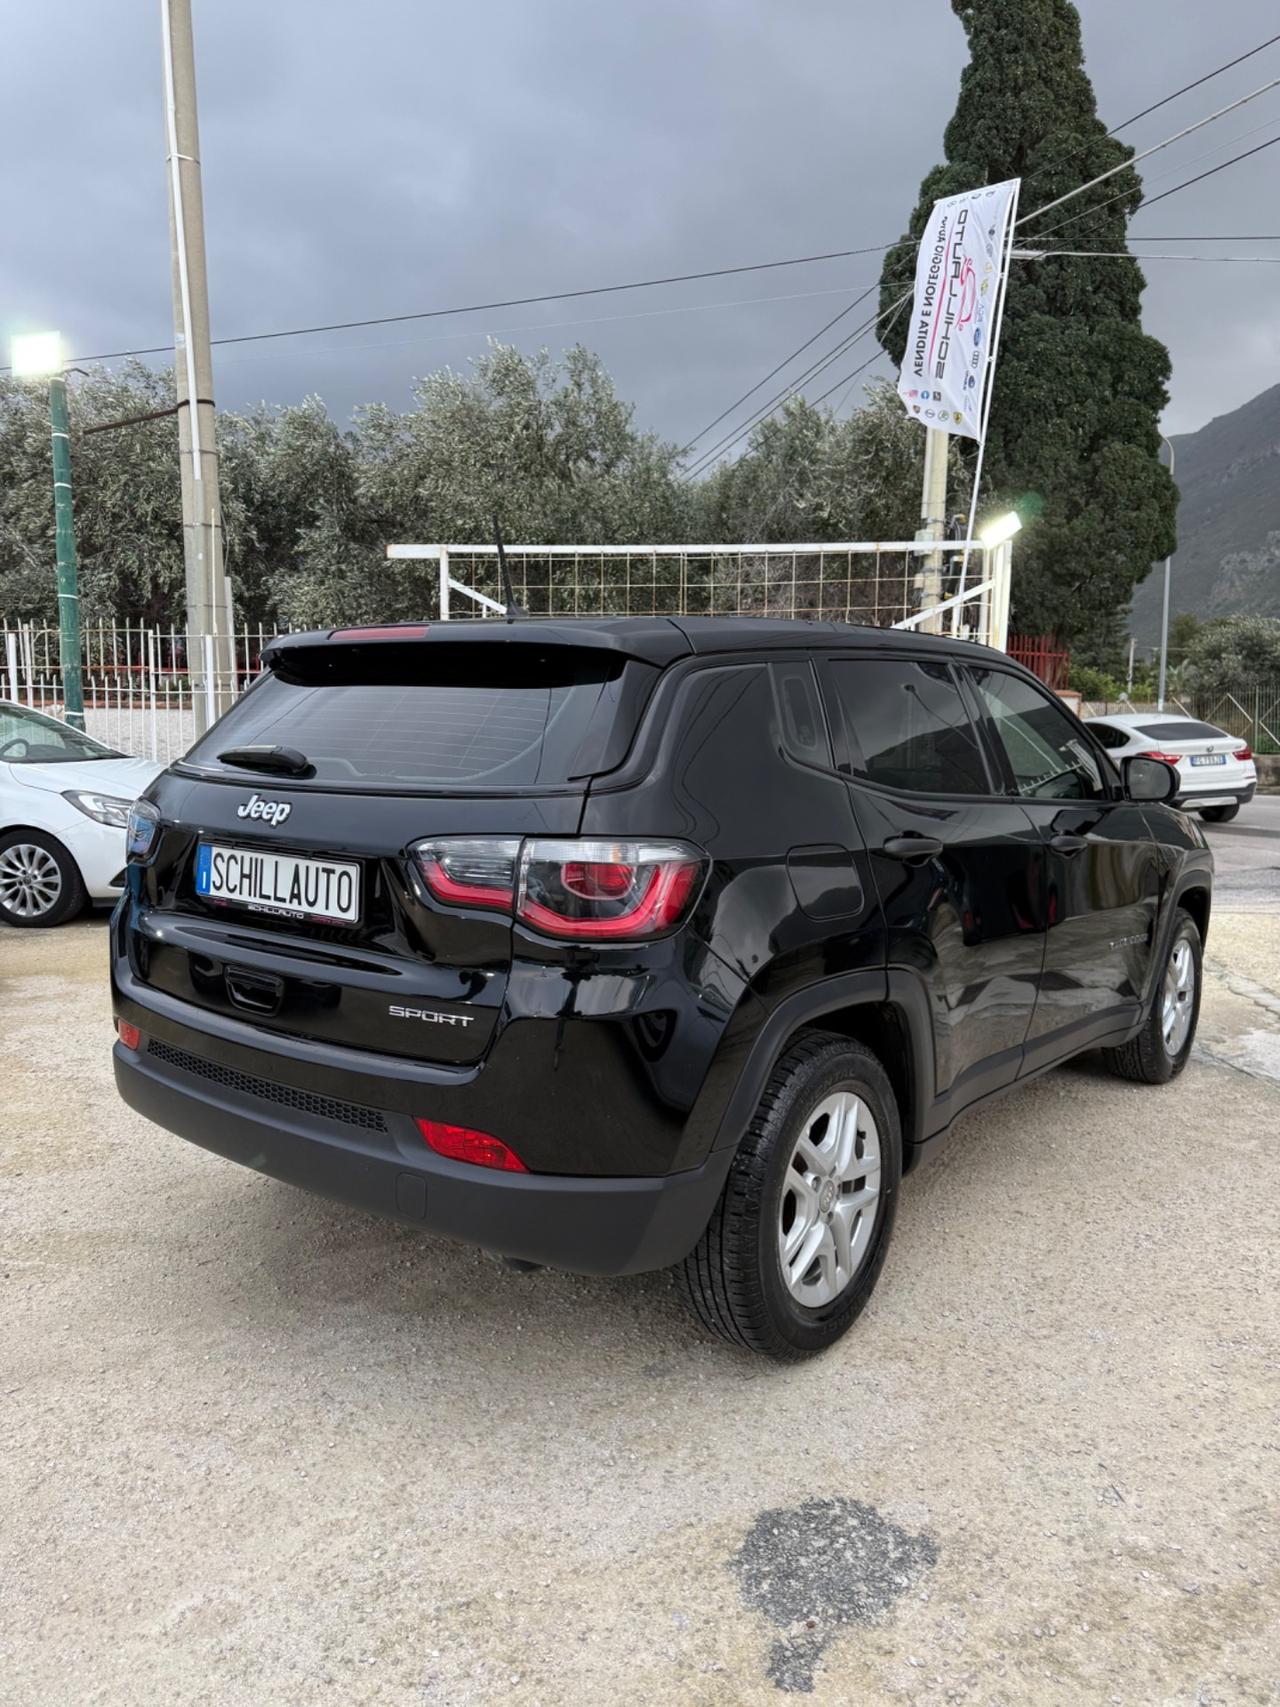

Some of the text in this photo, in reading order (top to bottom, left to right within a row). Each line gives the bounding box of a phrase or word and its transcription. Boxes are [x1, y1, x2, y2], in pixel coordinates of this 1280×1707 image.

[237, 794, 291, 826] Jeep
[212, 852, 353, 913] SCHILLAUTO
[388, 1005, 474, 1027] SPORT
